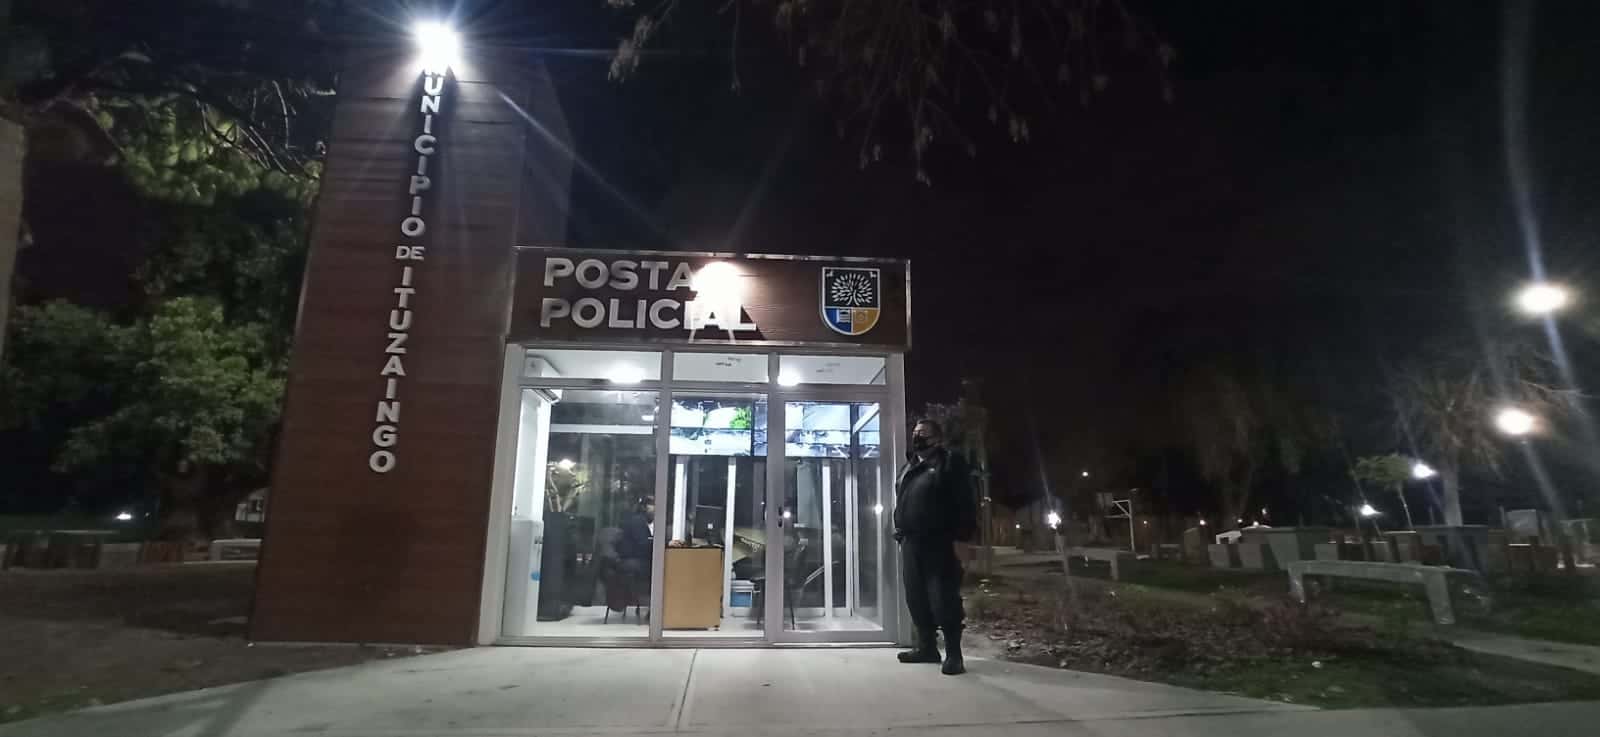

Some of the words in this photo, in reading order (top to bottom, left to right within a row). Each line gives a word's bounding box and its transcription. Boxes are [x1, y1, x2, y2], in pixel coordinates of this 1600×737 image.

[395, 246, 425, 261] DE
[543, 257, 699, 291] POSTA
[539, 297, 757, 331] POLICIAL
[369, 266, 416, 473] ITUZAINGO
